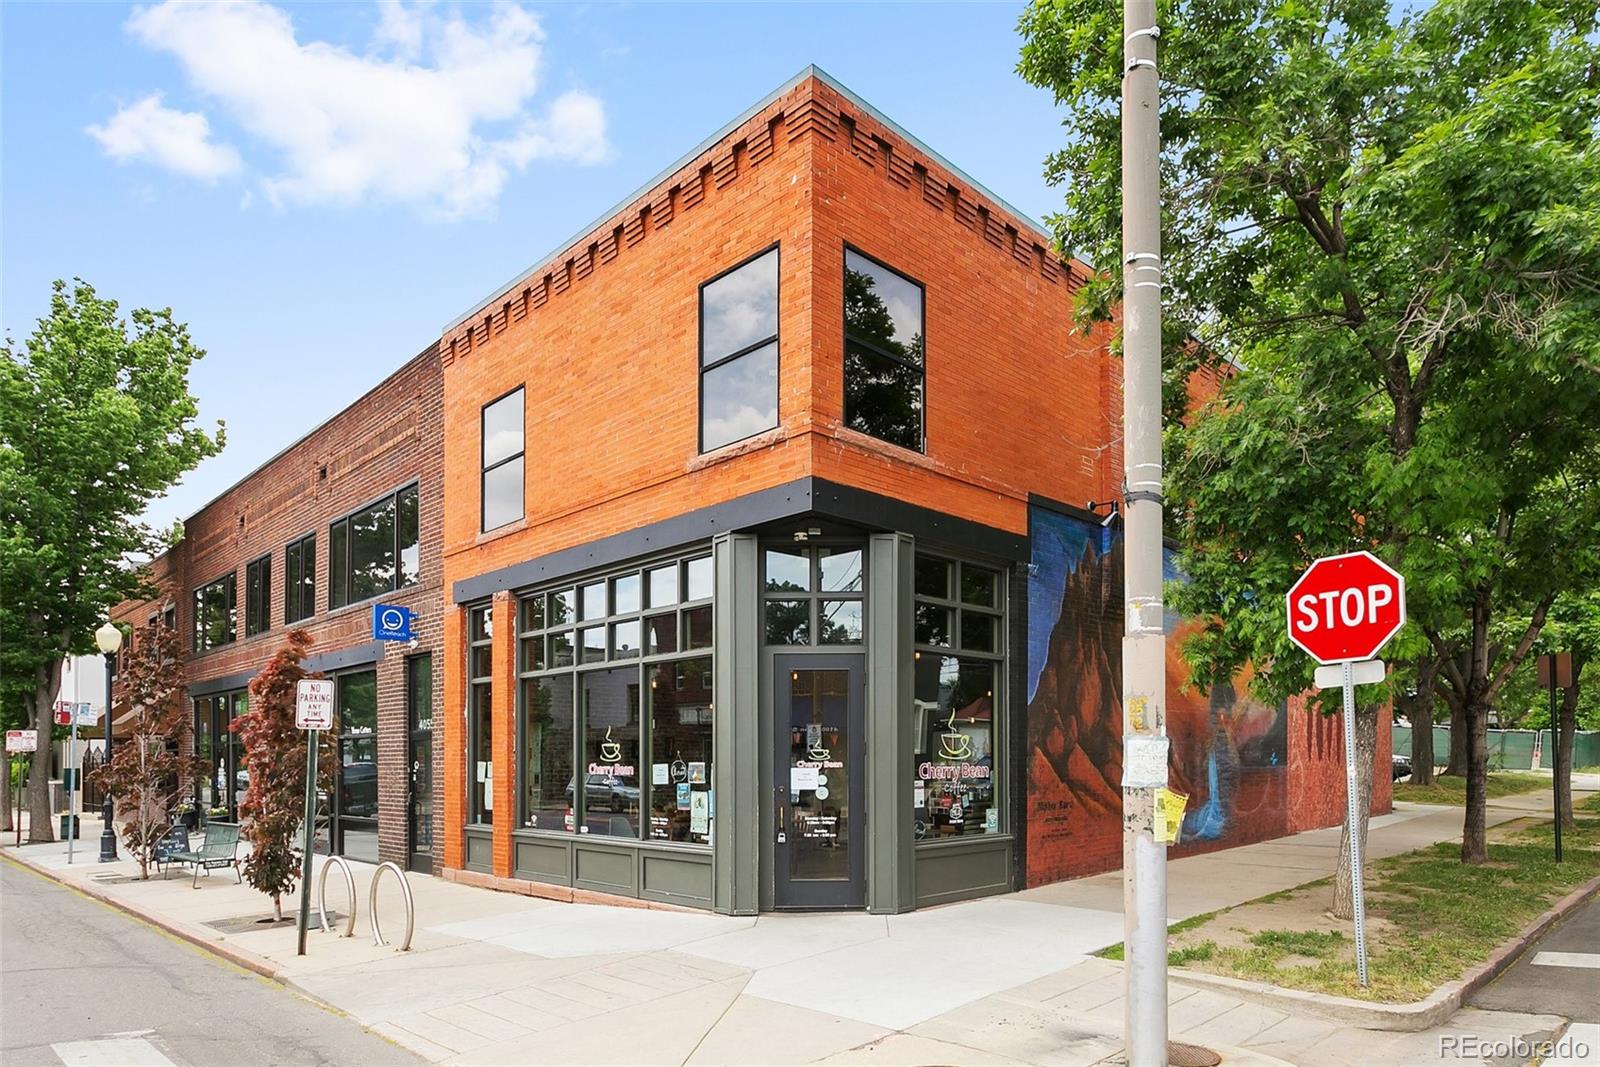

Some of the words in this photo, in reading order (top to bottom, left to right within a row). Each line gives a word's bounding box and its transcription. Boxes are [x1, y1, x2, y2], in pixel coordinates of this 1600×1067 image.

[1296, 583, 1393, 632] STOP
[310, 683, 321, 692] NO
[300, 693, 330, 703] PARKING
[589, 763, 614, 778] Cherry
[614, 763, 634, 775] Bean
[796, 760, 823, 769] Cherry
[823, 760, 843, 768] Bean
[919, 762, 961, 782] Cherry
[961, 762, 989, 778] Bean
